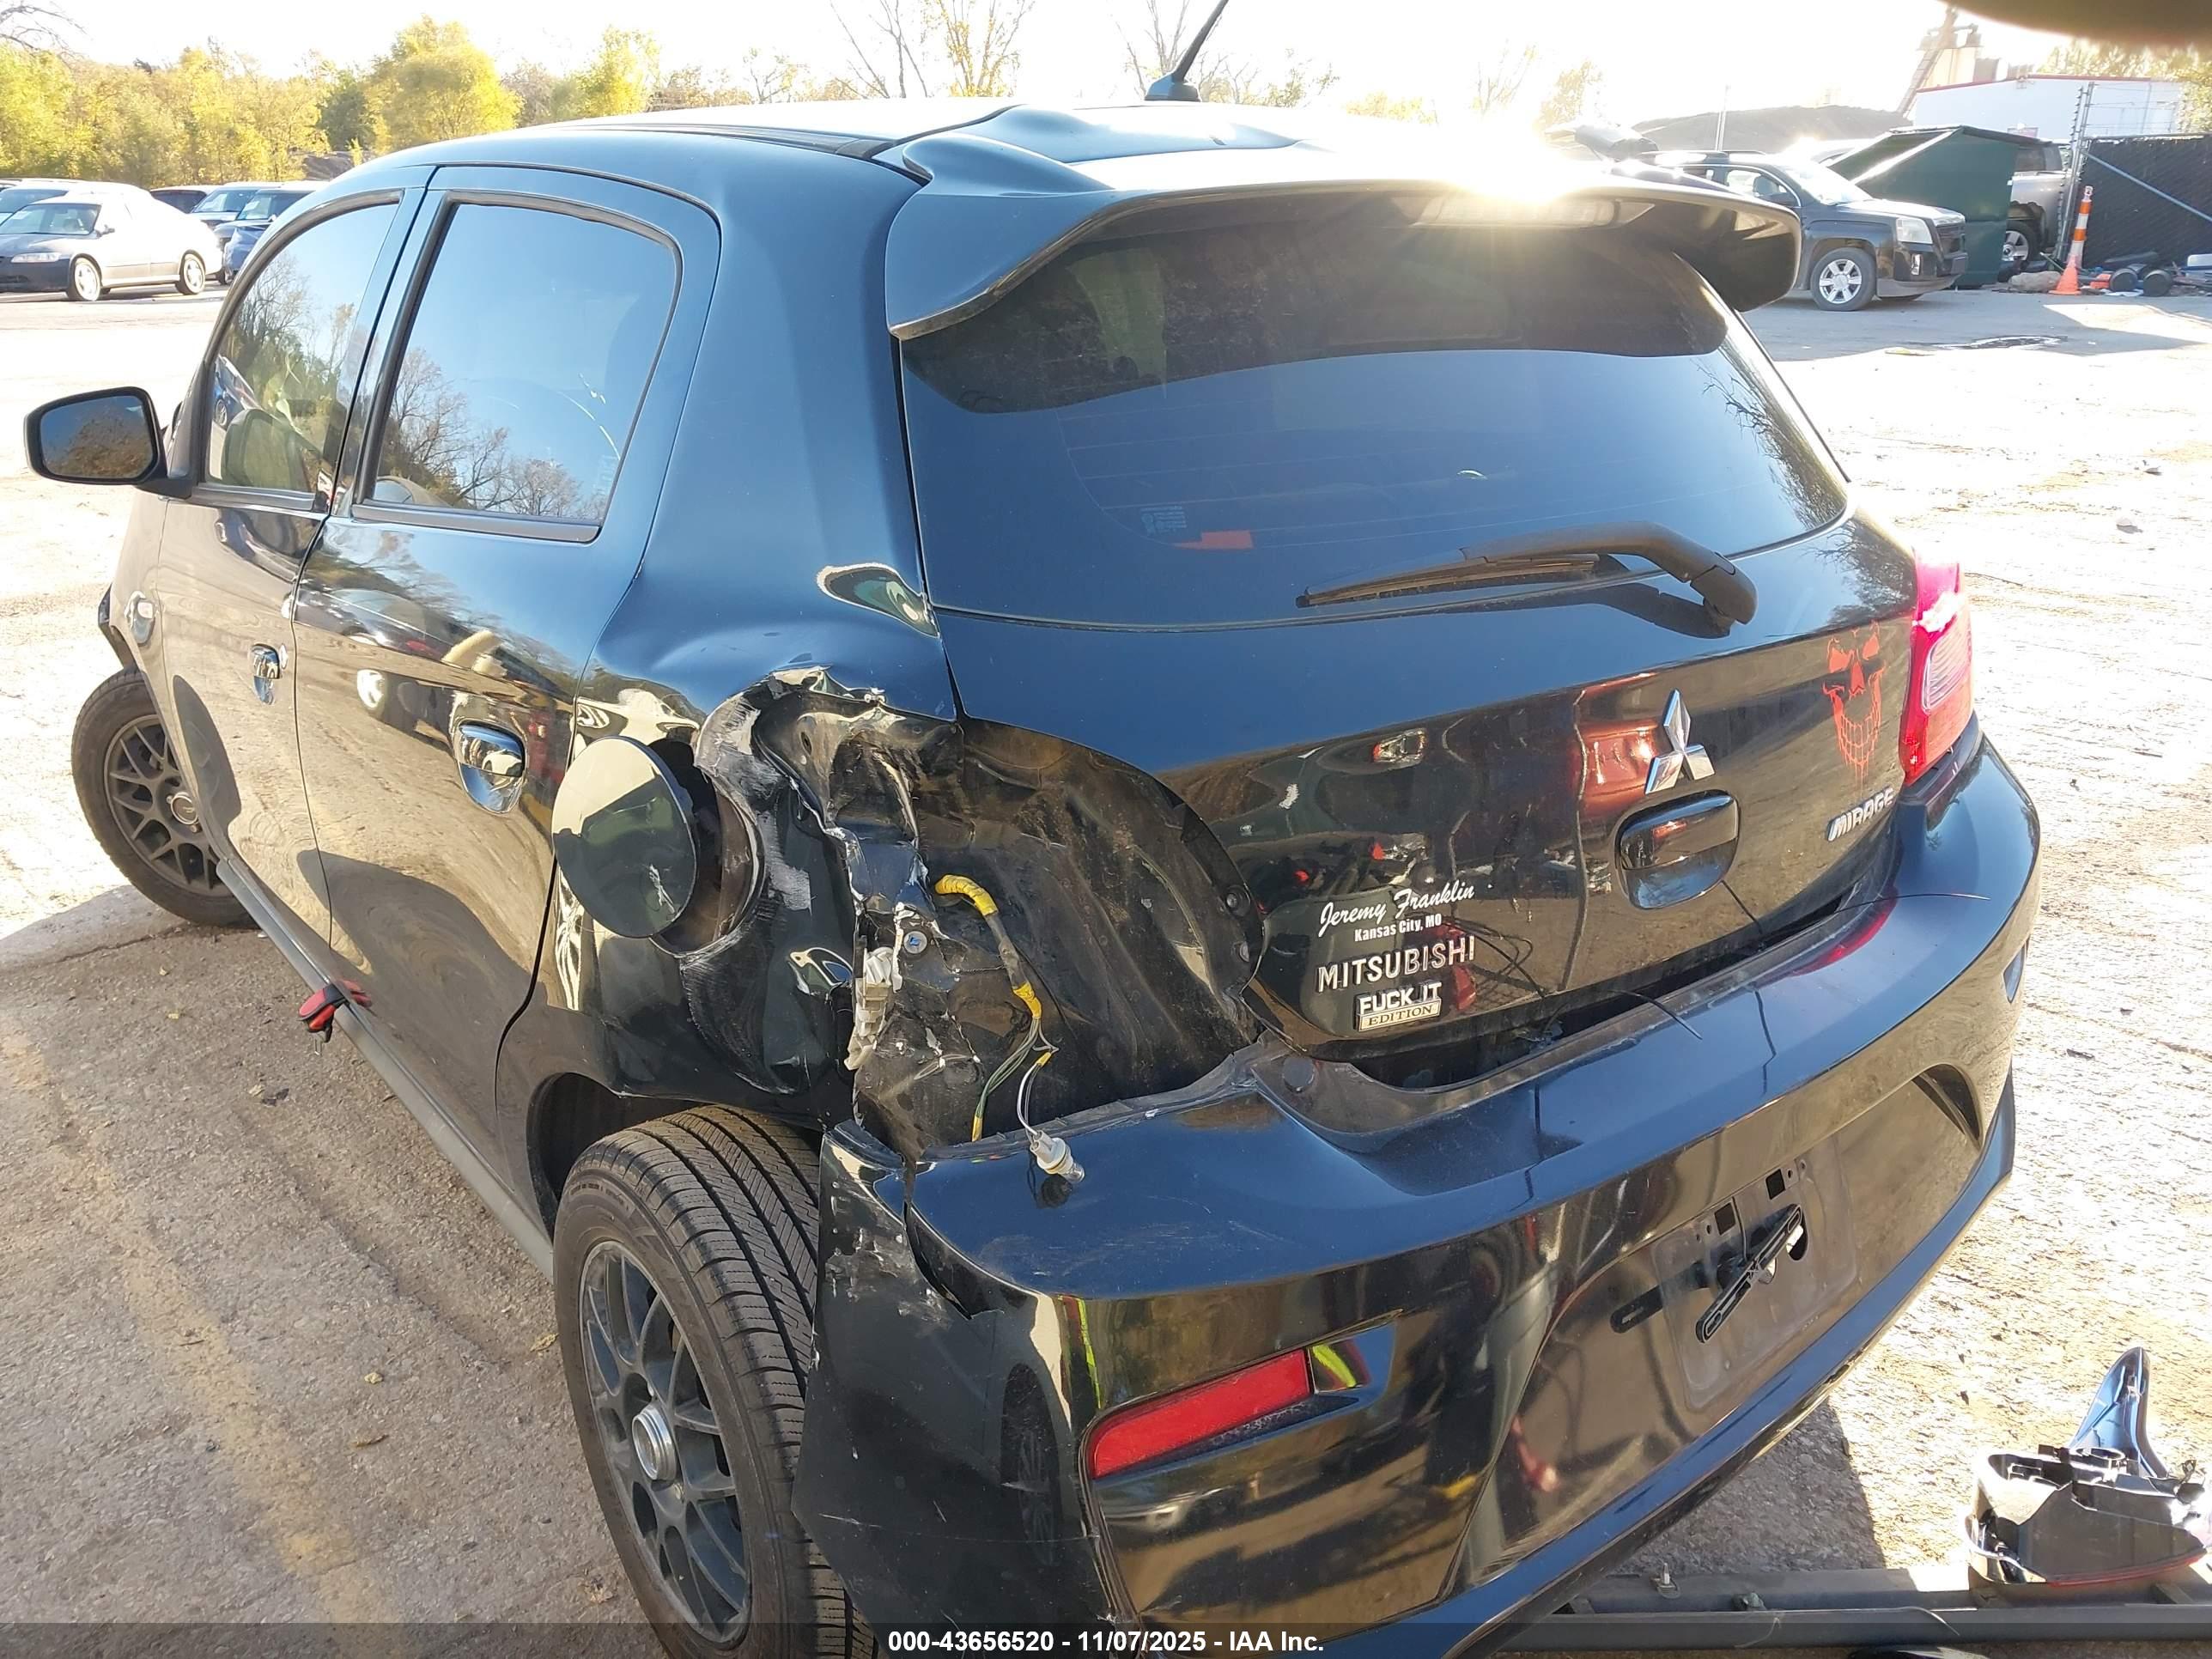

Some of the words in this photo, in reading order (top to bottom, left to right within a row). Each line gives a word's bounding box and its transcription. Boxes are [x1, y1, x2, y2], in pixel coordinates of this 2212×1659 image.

[1826, 787, 1894, 842] MIRAGE
[1318, 902, 1387, 938] Jeremy
[1394, 879, 1475, 918] Franklin
[1354, 923, 1396, 942] Kansas
[1399, 918, 1424, 933] City,
[1425, 914, 1443, 927] MO
[1317, 935, 1475, 993] MITSUBISHI
[1357, 987, 1416, 1015] FUCK
[1419, 981, 1443, 1001] IT
[1368, 1005, 1433, 1026] EDITION
